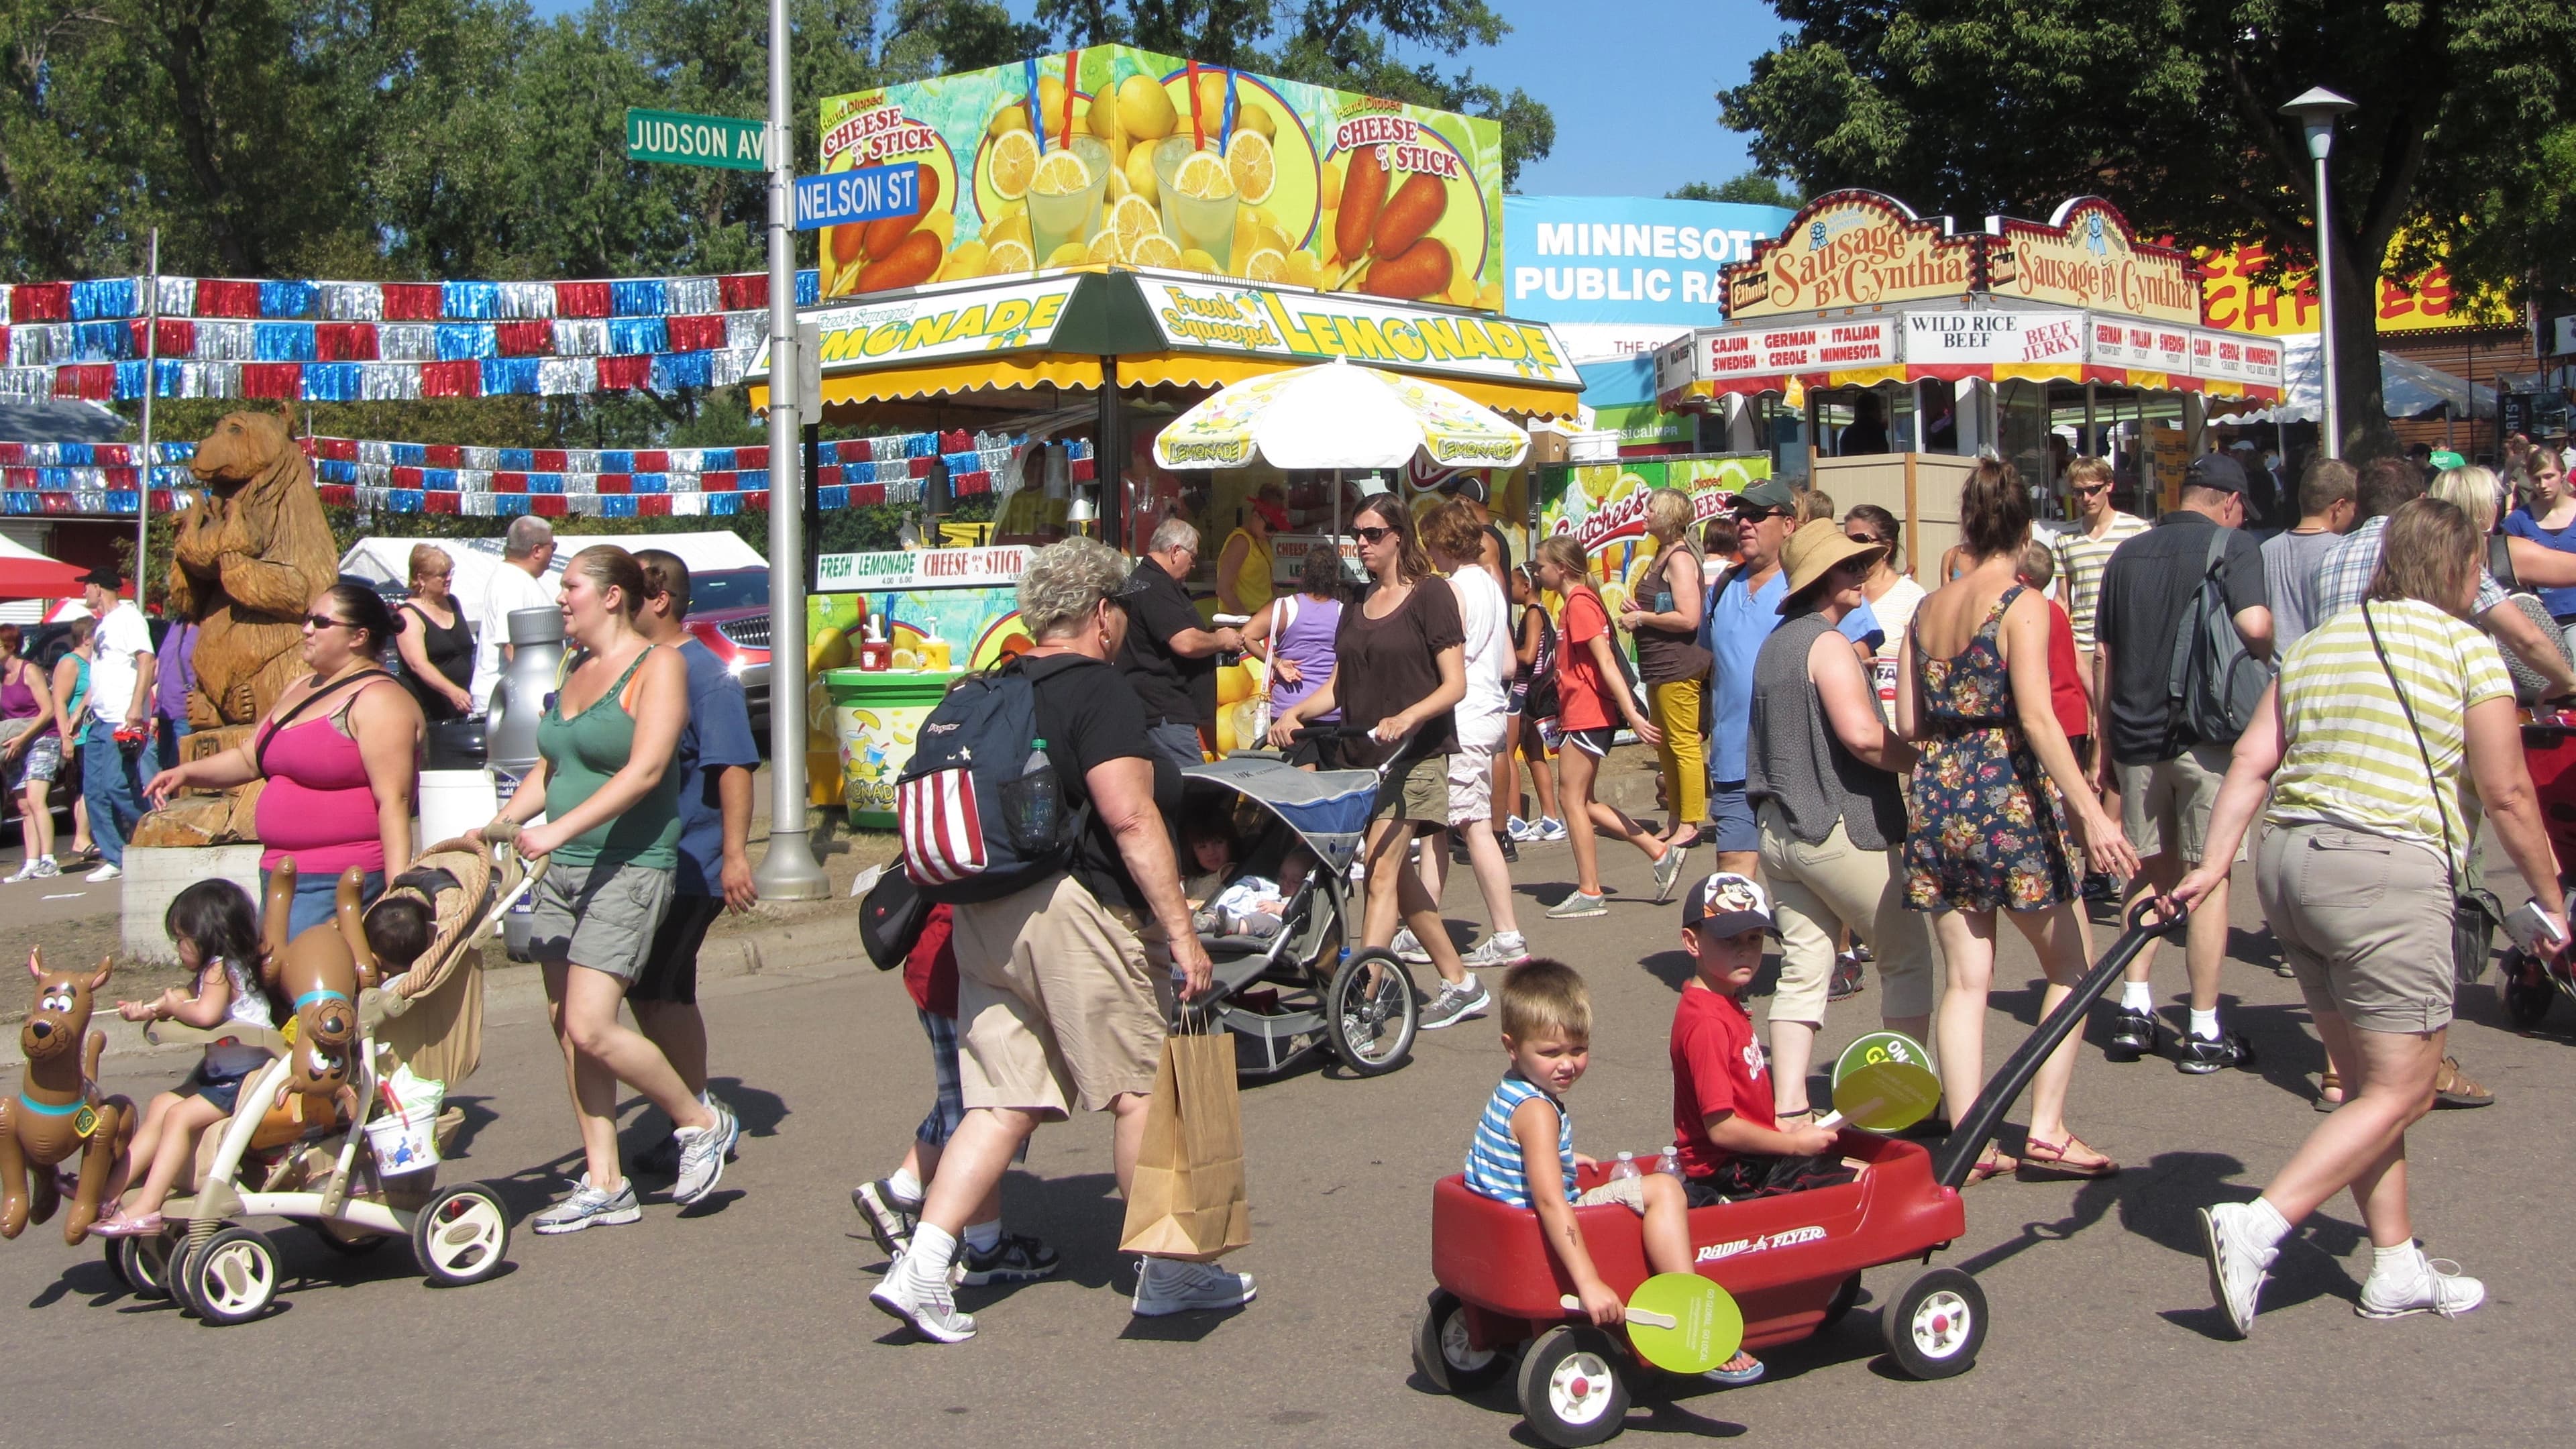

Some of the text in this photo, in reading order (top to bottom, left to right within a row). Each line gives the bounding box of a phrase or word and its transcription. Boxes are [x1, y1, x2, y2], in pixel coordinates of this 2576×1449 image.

[848, 93, 884, 113] Dipped
[1335, 95, 1403, 119] Hand Dipped
[630, 119, 765, 160] JUDSON AV
[824, 108, 902, 155] CHEESE
[871, 128, 934, 157] STICK
[1337, 117, 1417, 148] CHEESE
[1377, 146, 1387, 158] ON
[1396, 146, 1458, 177] STICK
[798, 171, 915, 222] NELSON ST
[1536, 222, 1766, 261] MINNESOT
[1733, 225, 1905, 307] Ethnic Sausage
[1814, 250, 1966, 307] BY Cynthia
[2018, 241, 2099, 309] Sausage
[2101, 260, 2118, 302] BY
[2121, 259, 2193, 314] Cynthia
[1515, 266, 1672, 301] PUBLIC
[816, 303, 918, 327] Fresh Squeezed
[1164, 286, 1242, 319] Fresh
[1162, 307, 1280, 351] Squeezed
[1263, 290, 1562, 368] LEMONADE
[1913, 316, 2018, 333] WILD RICE
[2025, 319, 2073, 345] BEEF
[1613, 341, 1644, 354] THE
[1711, 325, 1880, 354] CAJUN GERMAN ITALIAN
[1944, 333, 1992, 348] BEEF
[2021, 333, 2081, 362] JERKY
[2096, 325, 2186, 354] GERMAN ITALIAN SWEDISH
[2194, 338, 2211, 357] CAJUN
[2219, 341, 2240, 362] CREOLE
[2245, 346, 2278, 366] MINNESOTA
[1712, 344, 1881, 372] SWEDISH CREOLE MINNESOTA
[1169, 440, 1240, 464] LEMONADE
[1438, 439, 1514, 462] LEMONADE
[820, 555, 852, 579] FRESH
[859, 552, 916, 577] LEMONADE
[924, 552, 968, 578] CHEESE
[985, 549, 1023, 574] STICK
[1339, 544, 1358, 558] STIC
[882, 576, 913, 585] 4.00 6.00
[1695, 1226, 1826, 1263] RADIO FLYER
